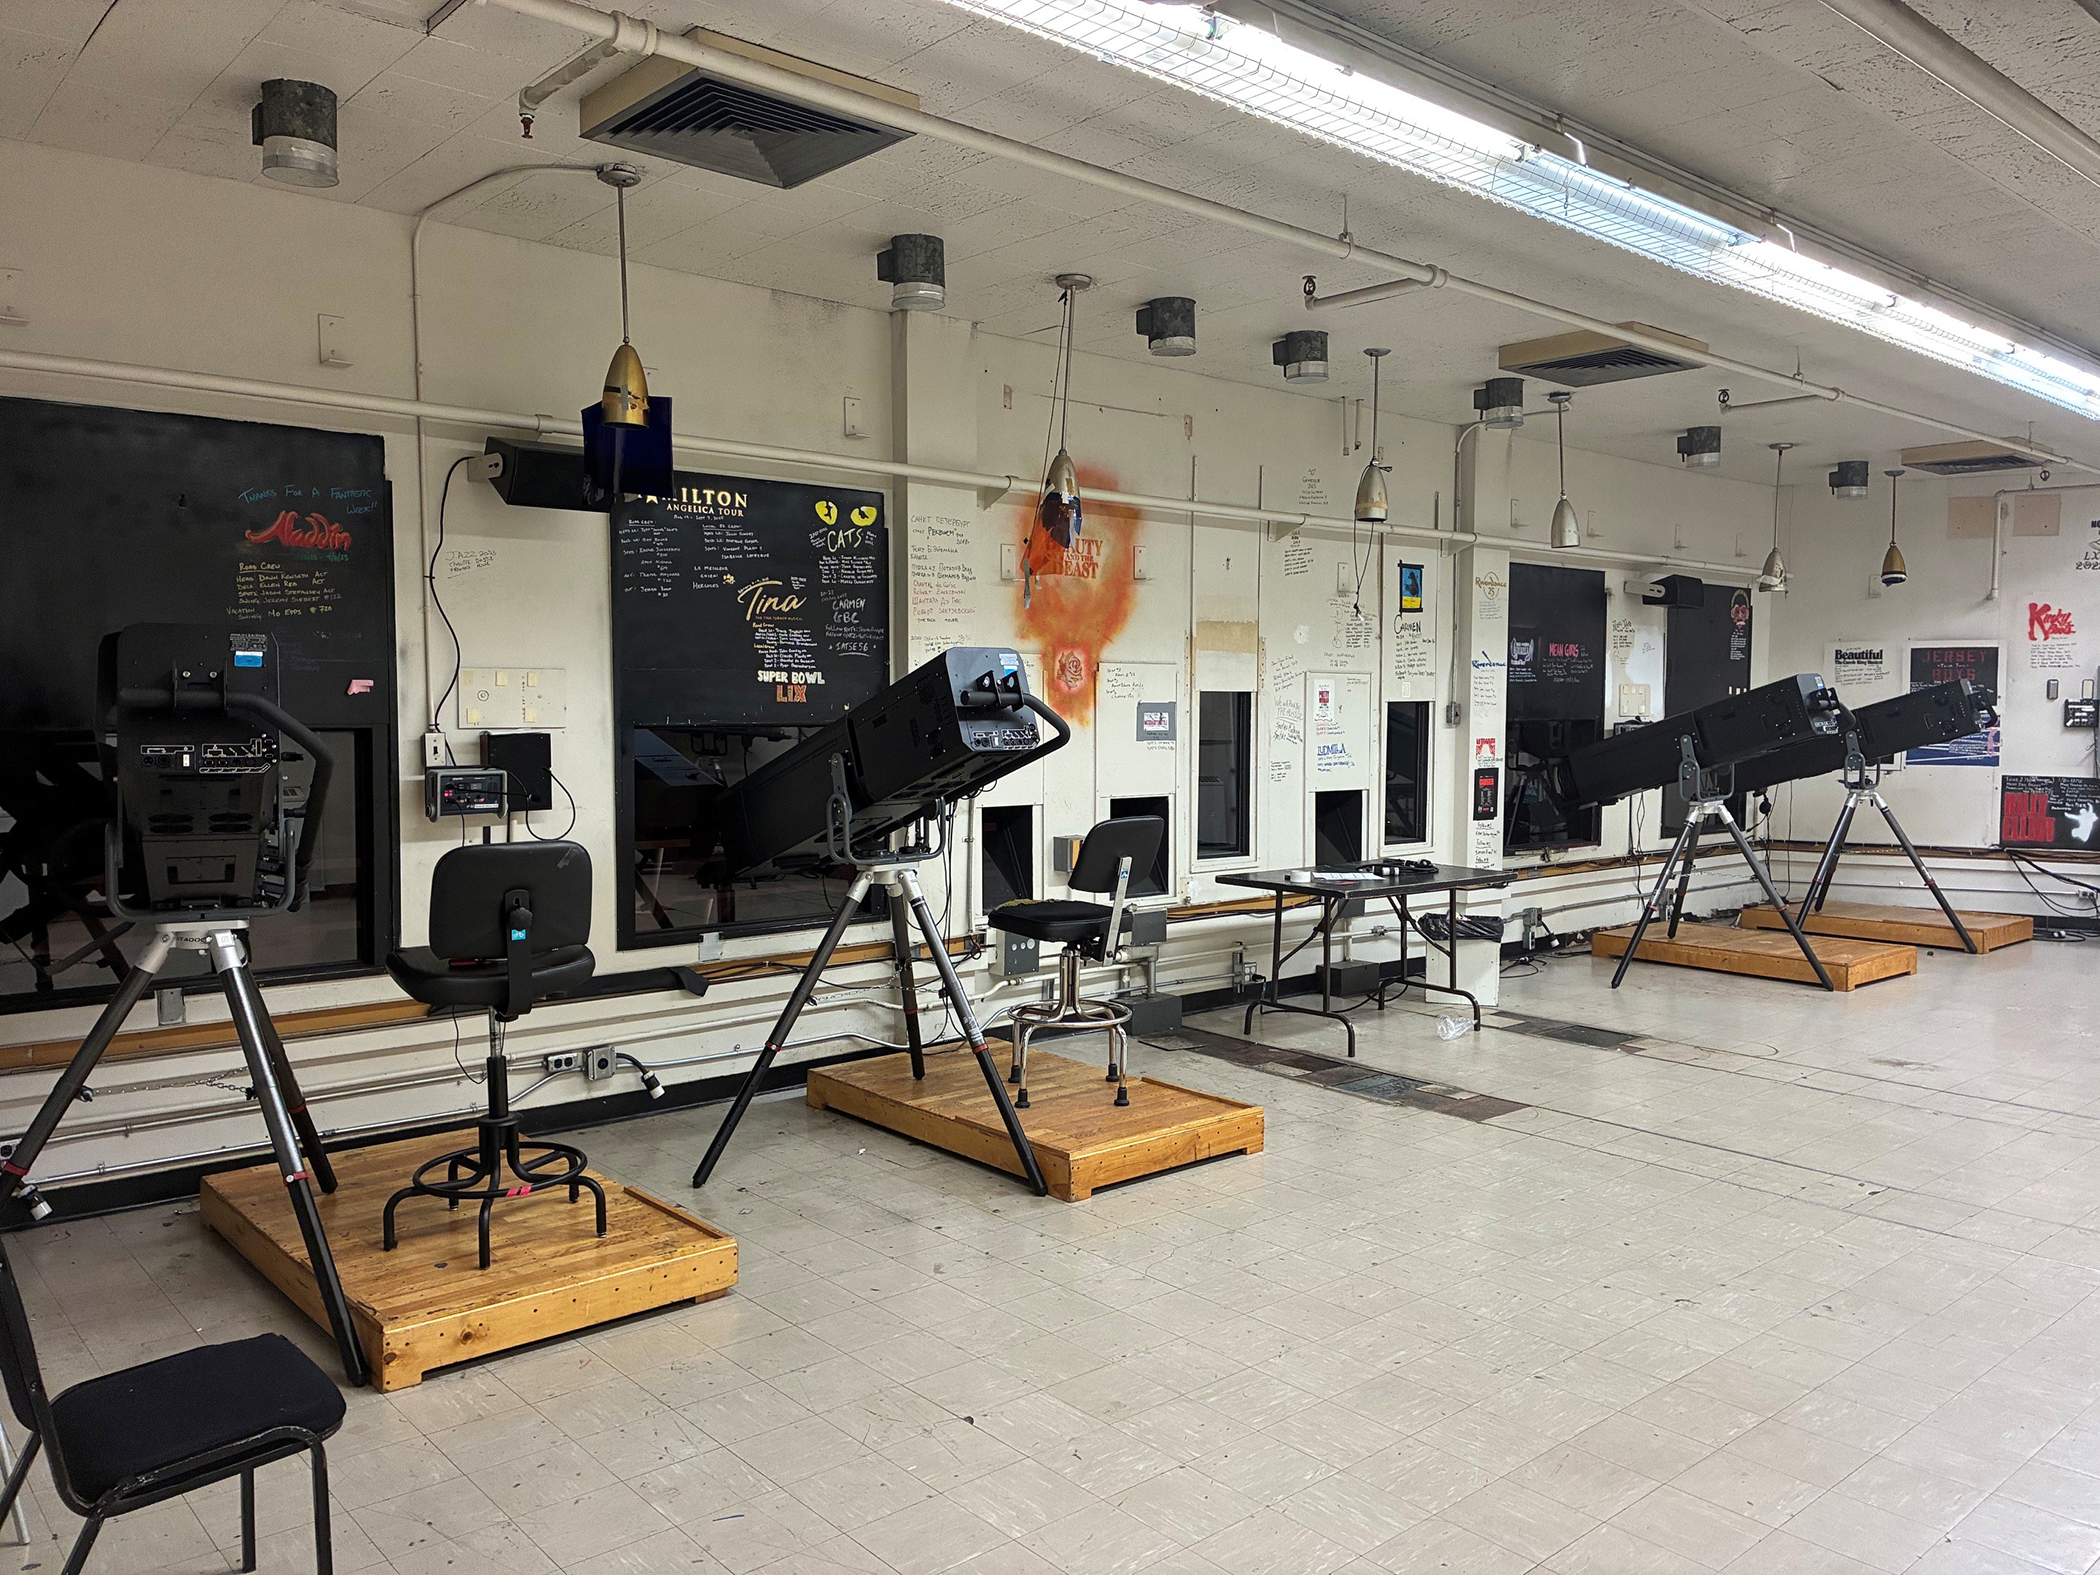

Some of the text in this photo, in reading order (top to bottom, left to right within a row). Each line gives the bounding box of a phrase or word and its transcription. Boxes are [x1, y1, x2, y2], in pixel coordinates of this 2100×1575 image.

[312, 487, 320, 498] A
[667, 503, 744, 517] ANGELICA TOUR
[245, 510, 352, 551] Aladdin
[827, 528, 863, 553] CATS
[1064, 561, 1099, 579] EAST
[2075, 562, 2100, 570] 202
[1488, 586, 1495, 597] 25
[737, 580, 807, 621] Tina
[832, 598, 866, 612] CARMEN
[2028, 603, 2071, 641] Kinky
[1549, 642, 1564, 657] MEAN
[1835, 649, 1883, 660] Beautiful
[1922, 650, 1987, 662] JERSEY
[757, 669, 825, 684] SUPER BOWL
[776, 684, 807, 703] LIX
[2004, 792, 2049, 818] BILLY
